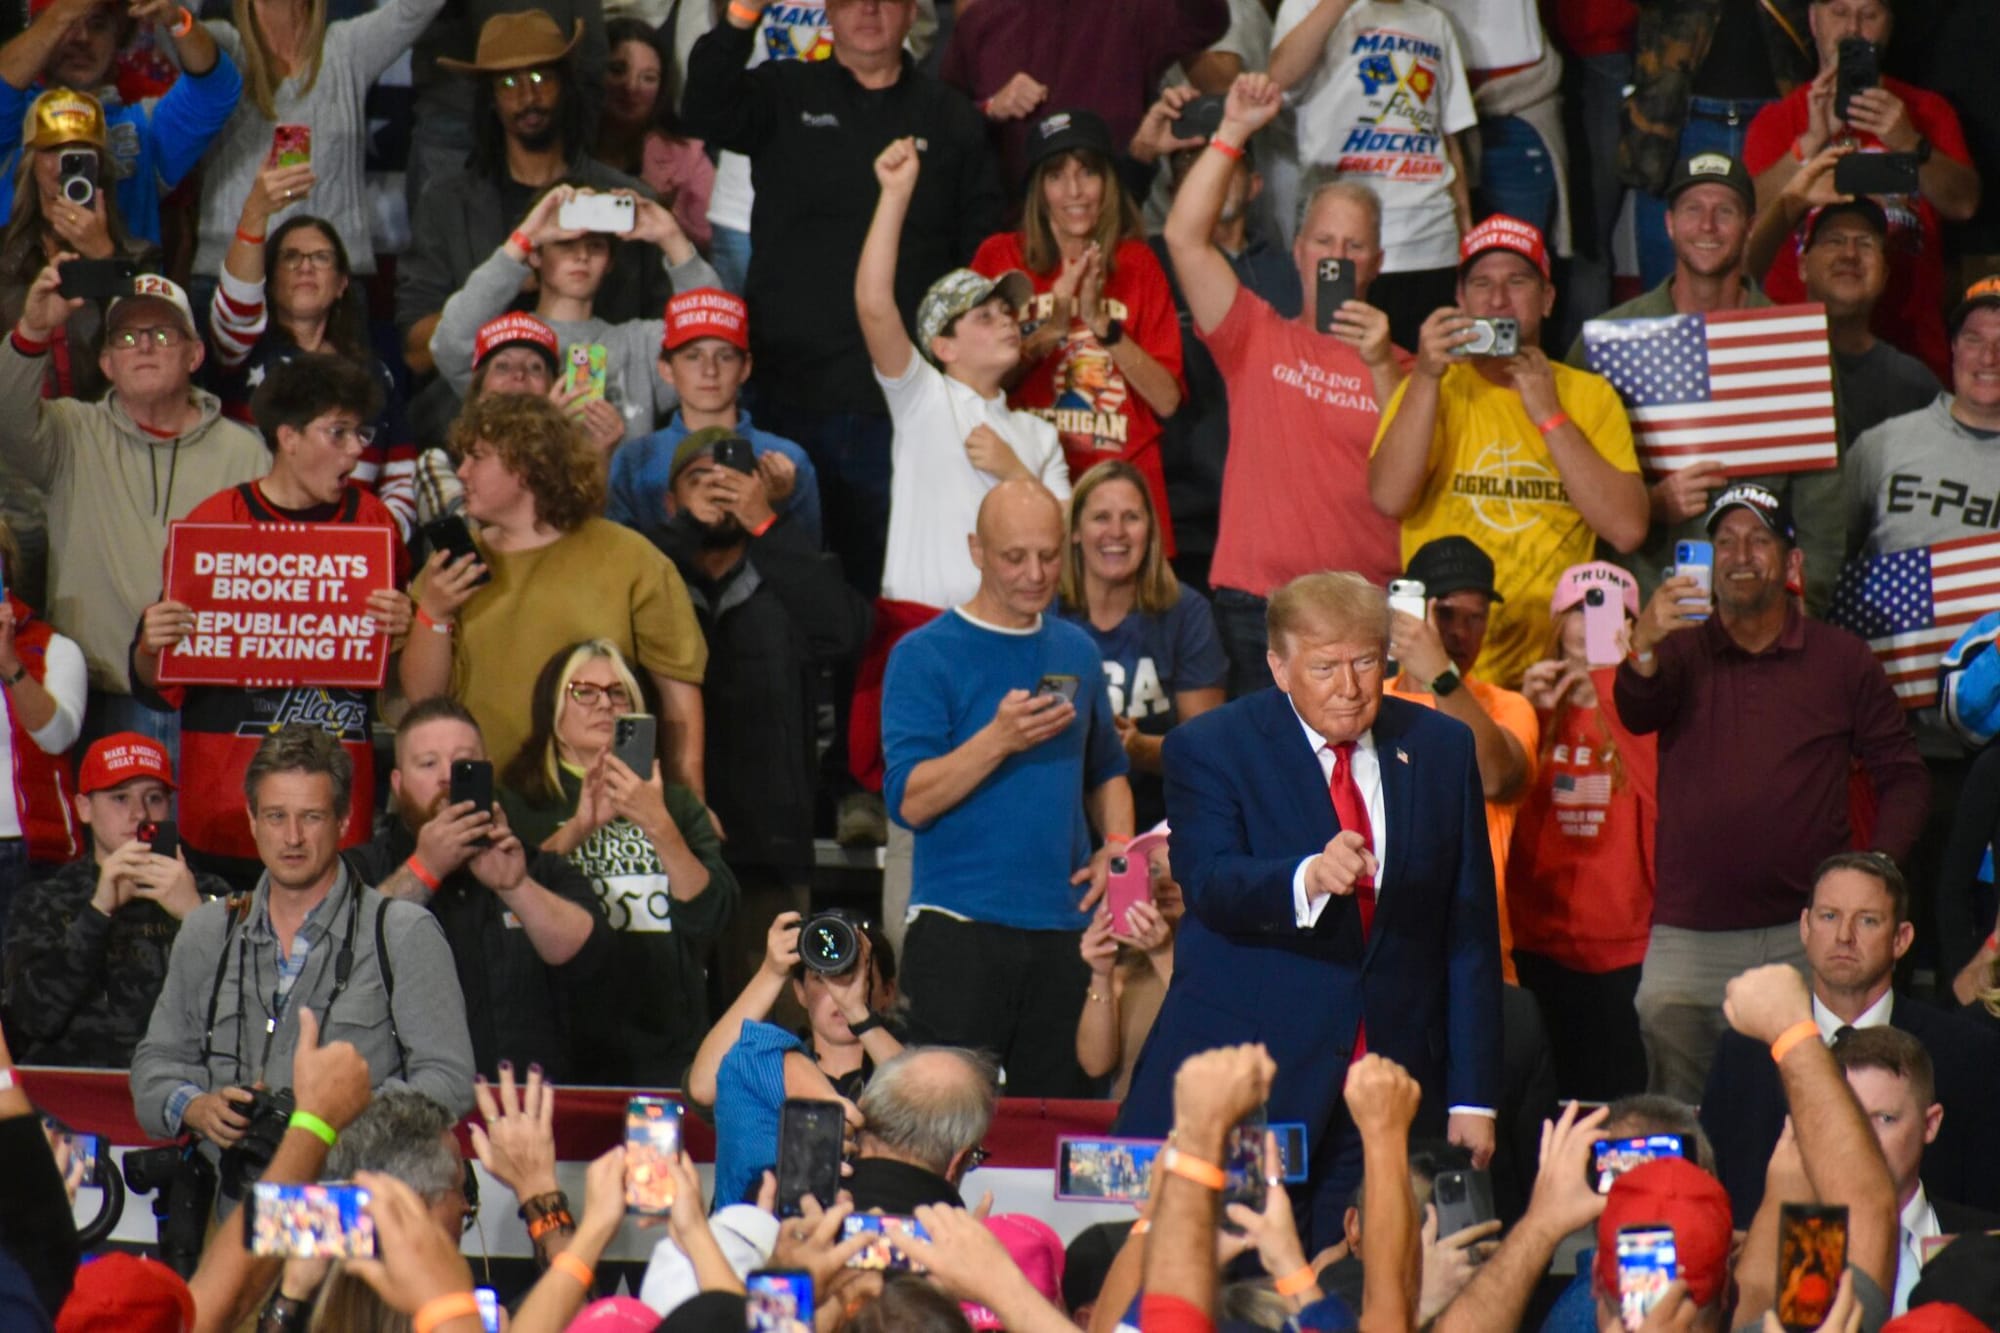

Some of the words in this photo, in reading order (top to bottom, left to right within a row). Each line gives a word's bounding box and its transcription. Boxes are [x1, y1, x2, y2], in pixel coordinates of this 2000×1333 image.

[763, 5, 829, 26] MAKI
[1351, 34, 1442, 61] MAKING
[1340, 128, 1440, 154] HOCKEY
[1395, 159, 1444, 176] AGAIN
[670, 295, 699, 315] MAKE
[700, 293, 745, 319] AMERICA
[1018, 292, 1128, 322] TRP
[675, 310, 708, 330] GREAT
[709, 311, 740, 331] AGAIN
[1323, 389, 1379, 414] AGAIN
[1018, 409, 1128, 443] HIGAN
[1714, 486, 1779, 510] TRUMP
[194, 552, 369, 579] DEMOCRATS
[1572, 568, 1631, 589] TRUMP
[211, 577, 311, 601] BROKE
[317, 579, 349, 604] IT.
[195, 611, 377, 637] EPUBLICANS
[172, 634, 233, 658] ARE
[239, 636, 336, 661] FIXING
[342, 638, 374, 662] IT.
[1102, 657, 1170, 718] SA
[103, 746, 127, 761] MAKE
[129, 744, 162, 761] AMERICA
[107, 755, 135, 771] GREAT
